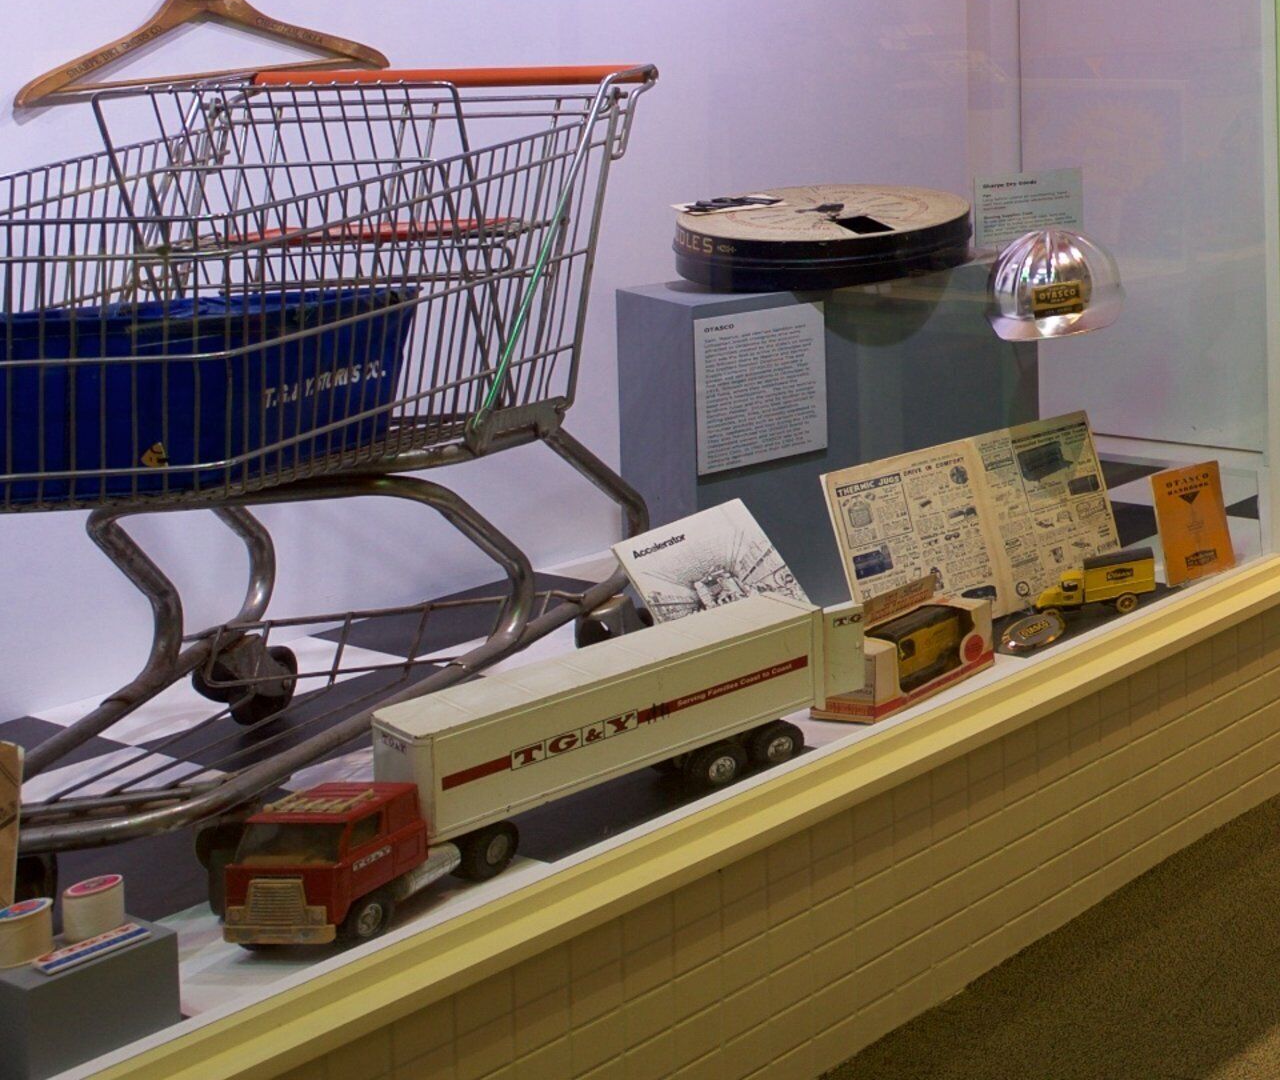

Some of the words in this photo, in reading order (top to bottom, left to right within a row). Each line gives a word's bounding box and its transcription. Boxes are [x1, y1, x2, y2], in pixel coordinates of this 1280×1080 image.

[704, 323, 735, 333] OTASCO
[837, 481, 875, 497] THERMIC
[632, 532, 686, 560] Accelerator
[677, 691, 706, 708] Serving
[762, 671, 770, 679] to
[514, 714, 634, 765] TG&Y
